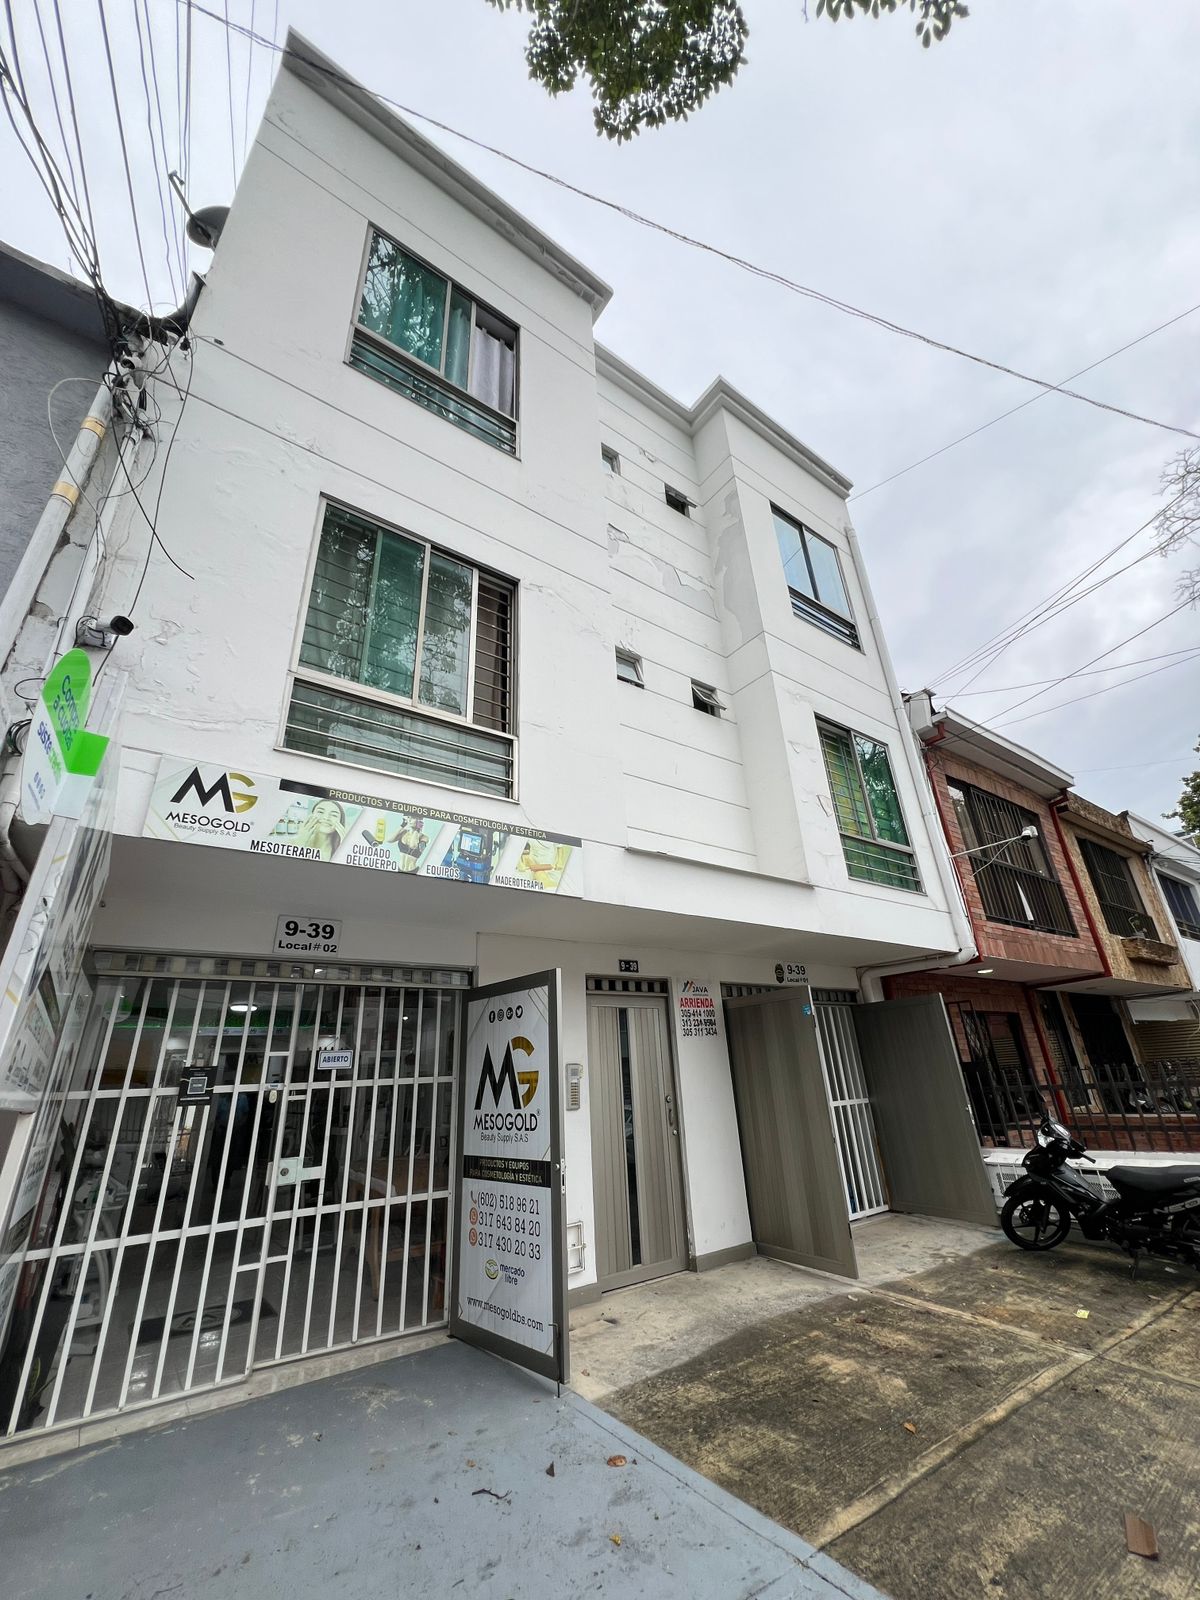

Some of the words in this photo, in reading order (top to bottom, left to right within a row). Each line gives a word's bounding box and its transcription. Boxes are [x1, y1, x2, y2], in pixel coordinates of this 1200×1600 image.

[170, 766, 259, 814] MG
[165, 811, 251, 833] MESOGOLD
[329, 789, 383, 808] PRODUCTOS
[384, 801, 391, 809] Y
[392, 802, 429, 816] EQUIPOS
[430, 809, 452, 821] PARA
[453, 814, 509, 832] COSMETOLOGÍA
[509, 824, 515, 833] Y
[515, 825, 547, 840] ESTÉTICA
[173, 823, 196, 832] Beauty
[197, 826, 219, 836] Supply
[250, 840, 321, 860] MESOTERAPIA
[352, 844, 391, 860] CUIDADO
[426, 864, 459, 878] EQUIPOS
[495, 875, 544, 891] MADEROTERAPIA
[284, 920, 335, 940] 9-39
[787, 964, 806, 975] 9-39
[680, 997, 715, 1009] ARRIENDA
[681, 1009, 691, 1018] 305
[683, 1027, 693, 1036] 305
[694, 1027, 704, 1037] 311
[322, 1055, 350, 1064] ABIERTO
[474, 1036, 540, 1110] MG
[473, 1113, 538, 1131] MESOGOLD
[480, 1132, 497, 1143] Beauty
[496, 1132, 514, 1144] Supply
[479, 1158, 505, 1168] PRODUCTOS
[505, 1161, 509, 1169] Y
[508, 1161, 530, 1171] EQUIPOS
[481, 1169, 515, 1181] COSMETOLOGÍA
[515, 1173, 519, 1181] Y
[519, 1172, 543, 1184] ESTÉTICA
[477, 1192, 498, 1212] (602)
[499, 1194, 515, 1211] 518
[516, 1197, 527, 1213] 96
[528, 1199, 541, 1216] 21
[478, 1211, 494, 1228] 317
[496, 1214, 512, 1232] 643
[514, 1216, 526, 1234] 84
[528, 1220, 541, 1237] 20
[478, 1232, 494, 1249] 317
[495, 1234, 512, 1254] 430
[514, 1238, 526, 1257] 20
[528, 1242, 541, 1261] 33
[500, 1262, 526, 1278] mercado
[504, 1274, 518, 1286] libre
[466, 1295, 545, 1333] www.mesogoldbs.com
